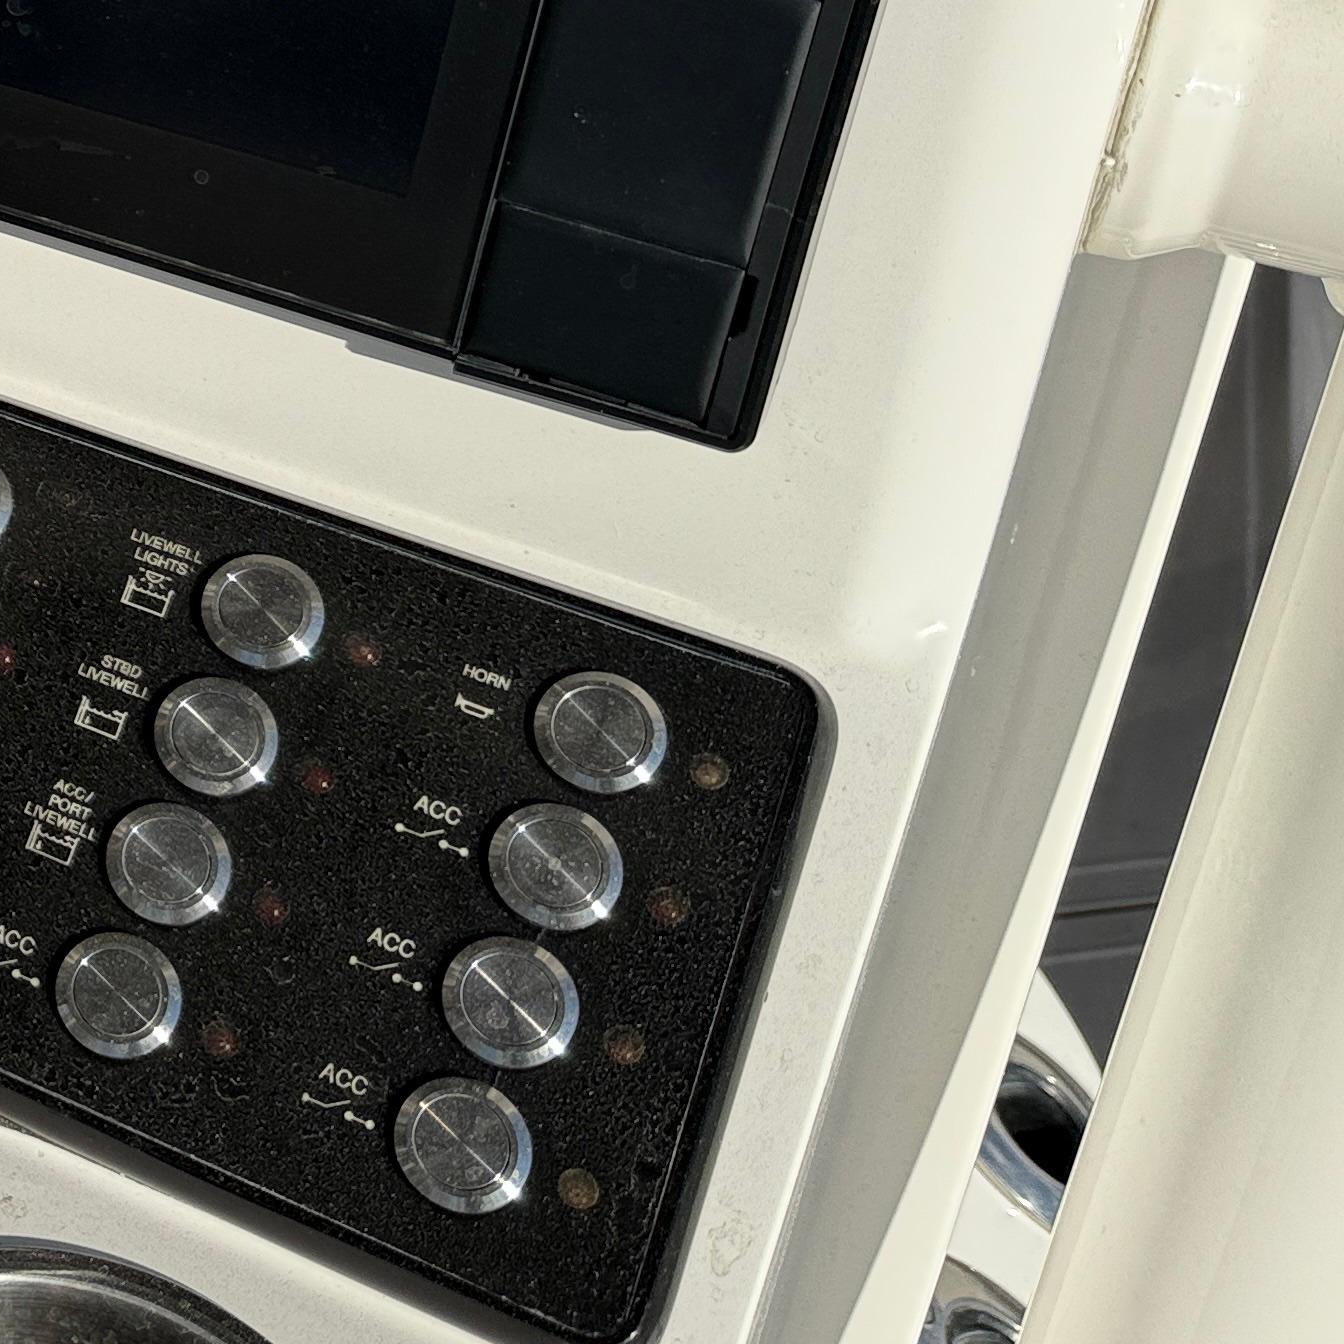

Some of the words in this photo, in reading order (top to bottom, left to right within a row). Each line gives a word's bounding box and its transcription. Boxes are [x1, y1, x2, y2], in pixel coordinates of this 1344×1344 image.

[130, 528, 203, 565] LIVEWELL
[134, 546, 189, 576] LIGHTS
[78, 662, 150, 702] LIVEWELL
[100, 654, 143, 679] STBD
[462, 663, 512, 691] HORN
[23, 800, 96, 843] LIVEWELL
[48, 793, 93, 821] PORT
[413, 795, 463, 826] ACC
[366, 927, 417, 959] ACC
[318, 1062, 369, 1096] ACC
